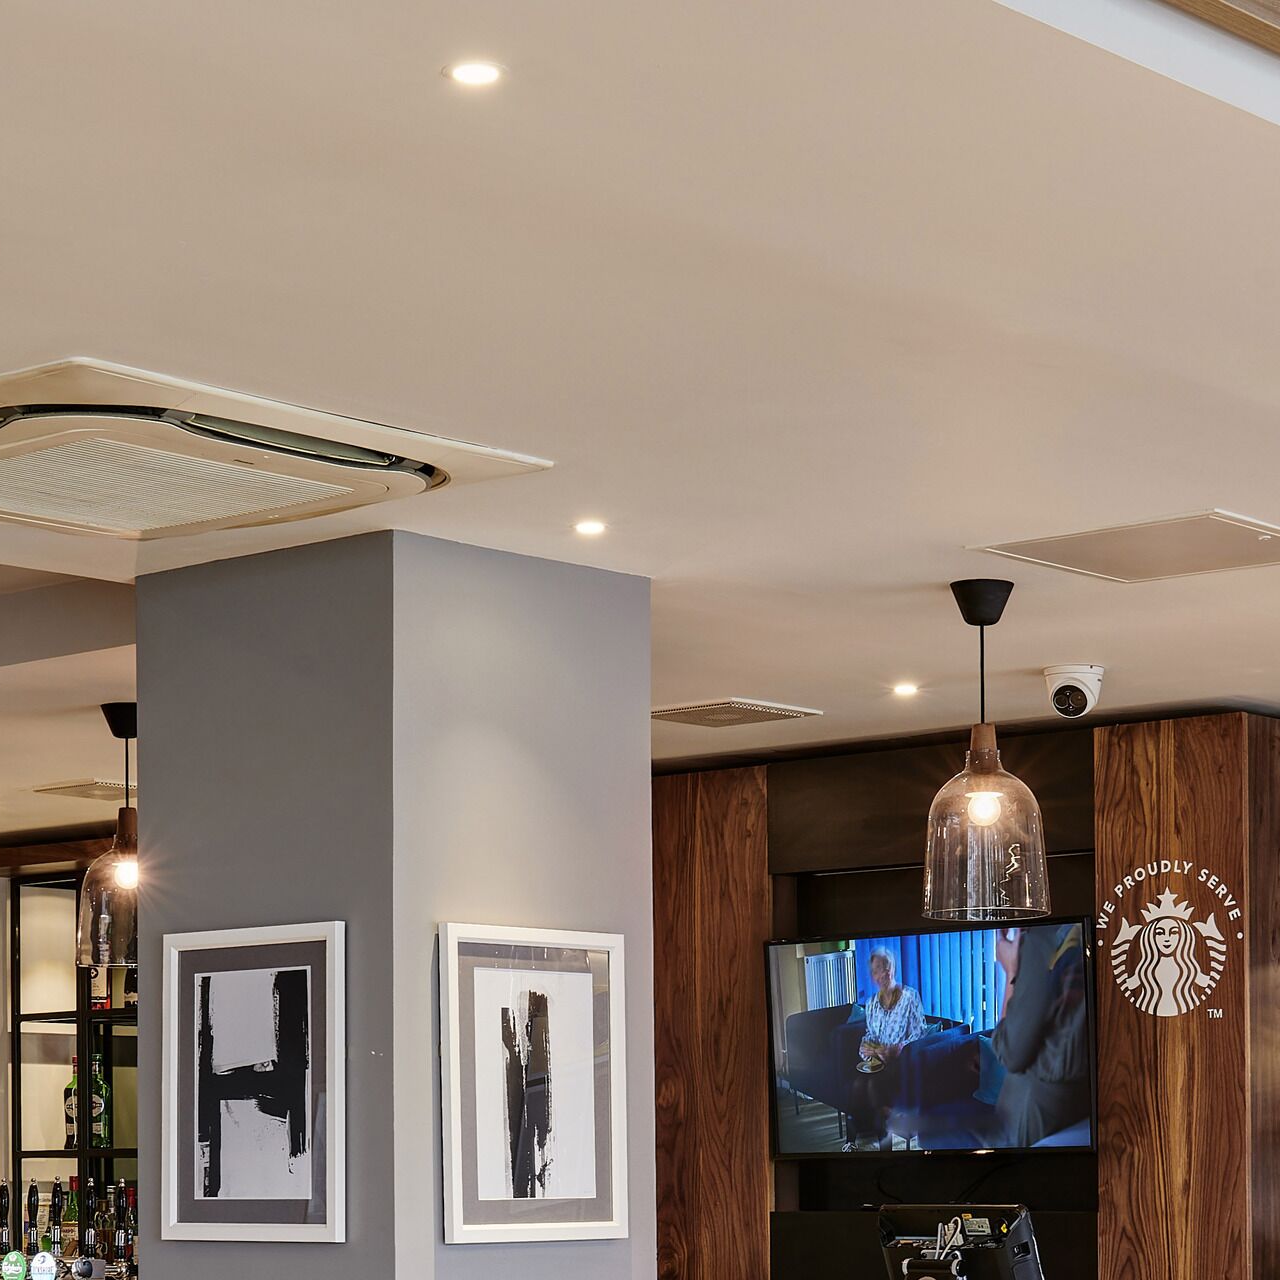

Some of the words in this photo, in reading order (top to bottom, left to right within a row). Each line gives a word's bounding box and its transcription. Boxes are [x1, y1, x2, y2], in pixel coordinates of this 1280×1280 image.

[1096, 900, 1116, 929] WE
[1114, 859, 1193, 898] PROUDLY
[1197, 869, 1241, 922] SERVE
[1207, 1009, 1223, 1019] TM
